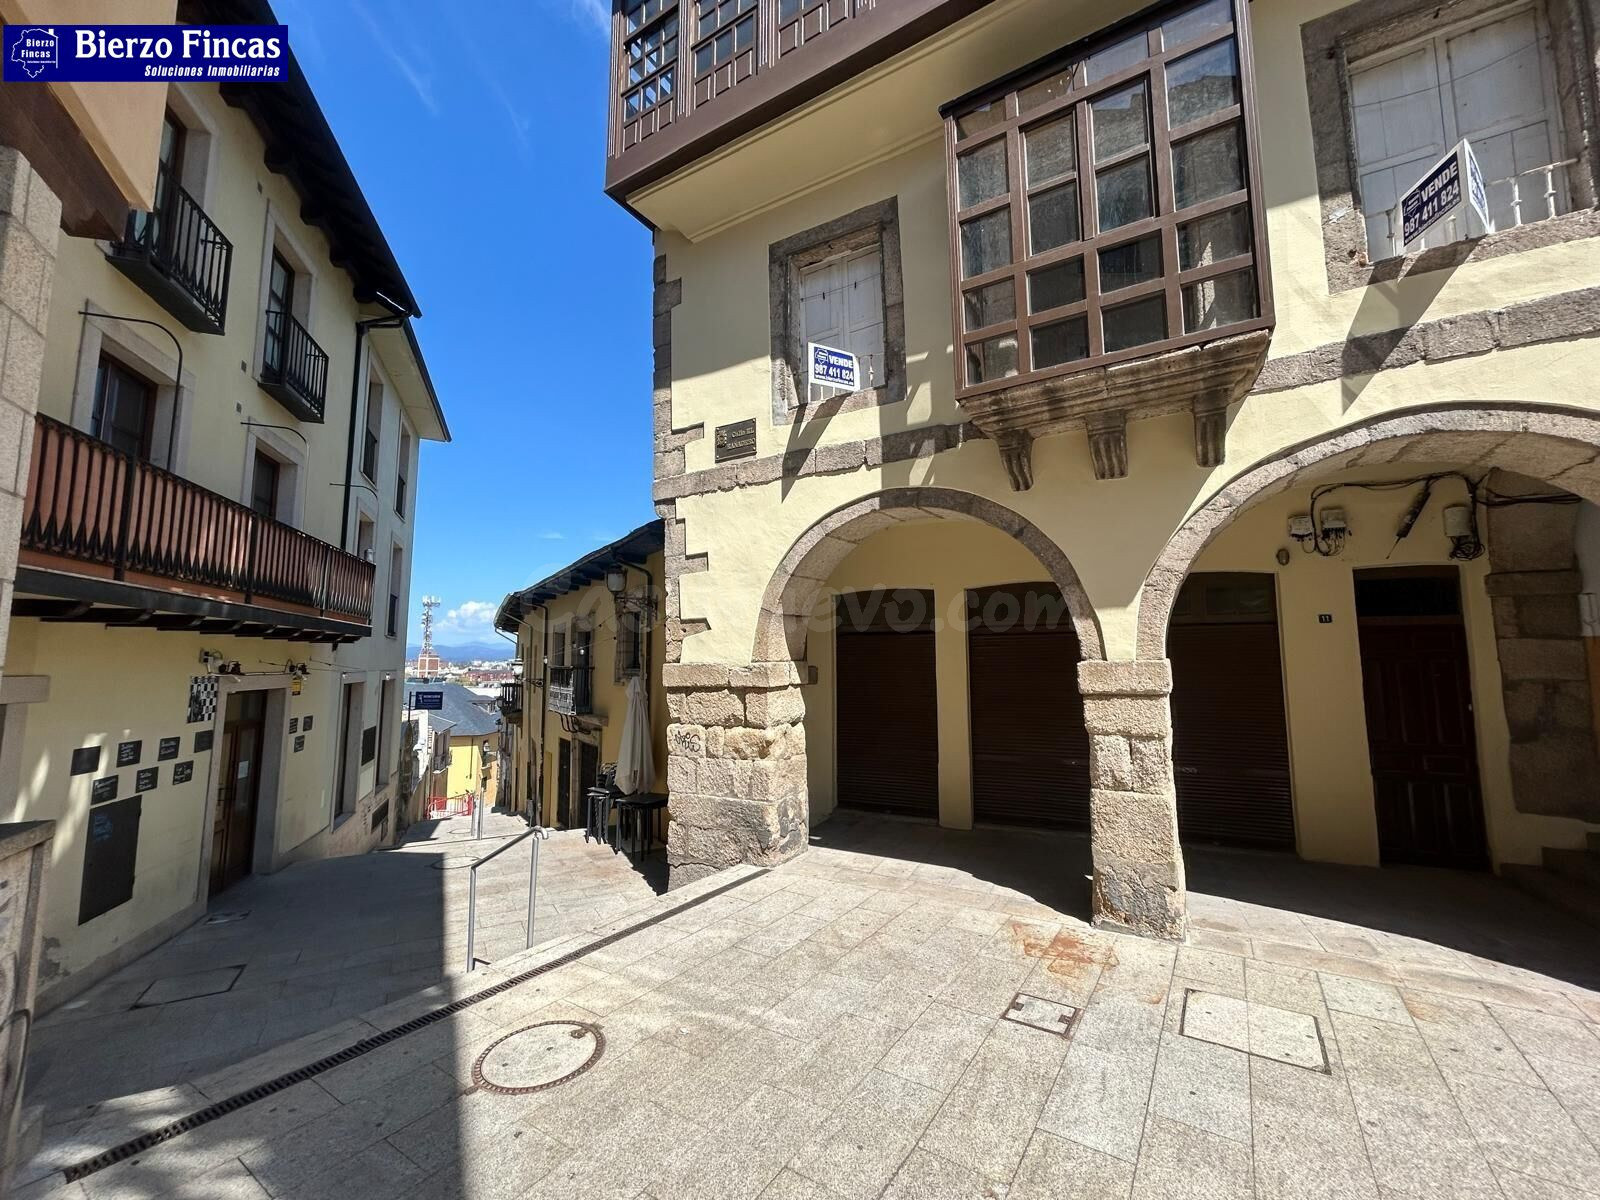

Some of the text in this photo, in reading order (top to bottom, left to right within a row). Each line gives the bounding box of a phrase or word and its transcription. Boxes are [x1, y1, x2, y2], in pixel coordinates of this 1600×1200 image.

[1420, 161, 1458, 201] VENDE
[1404, 213, 1420, 236] 987
[1422, 197, 1438, 220] 411
[1440, 180, 1459, 206] 824
[829, 355, 853, 369] VENDE
[829, 366, 840, 378] 411
